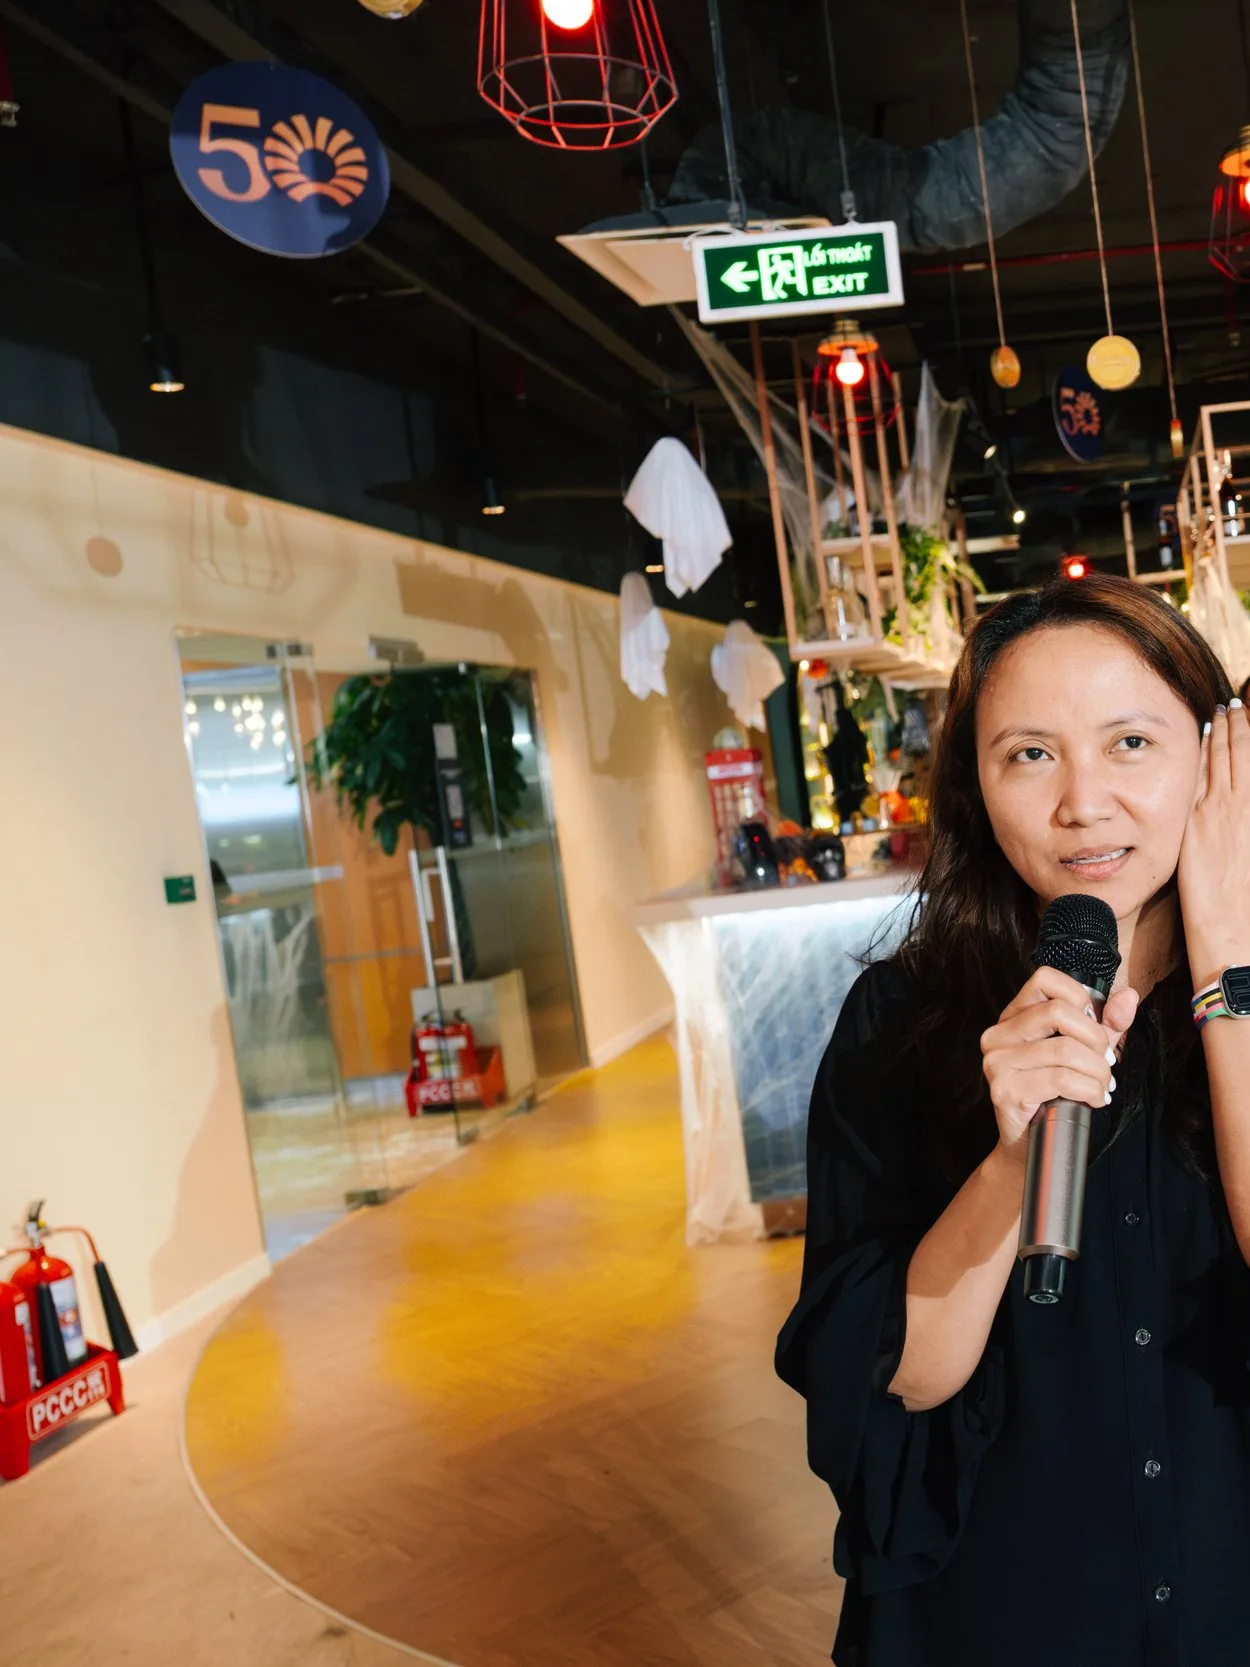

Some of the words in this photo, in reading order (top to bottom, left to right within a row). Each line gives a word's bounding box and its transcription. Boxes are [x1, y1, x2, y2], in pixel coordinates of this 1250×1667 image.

[197, 102, 370, 208] 50
[812, 271, 869, 296] EXIT
[32, 1379, 88, 1433] PCCC
